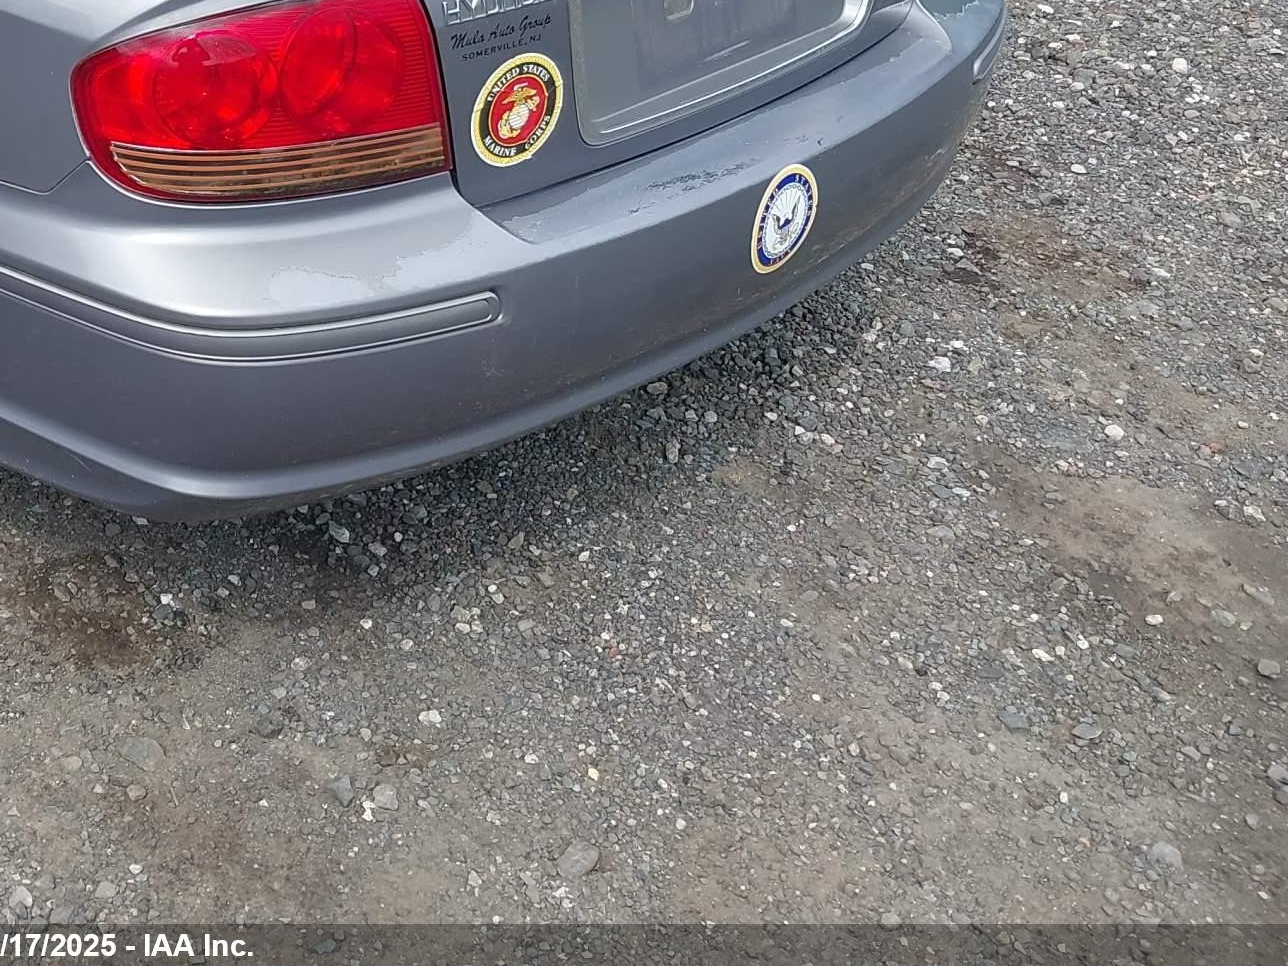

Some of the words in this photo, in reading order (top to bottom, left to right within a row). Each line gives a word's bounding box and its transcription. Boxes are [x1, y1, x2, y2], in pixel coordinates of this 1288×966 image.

[519, 13, 552, 37] Group
[529, 33, 542, 43] NJ
[487, 68, 520, 102] UNITED
[522, 63, 551, 82] STATES
[483, 134, 517, 157] MARINE
[524, 114, 551, 150] CORPS
